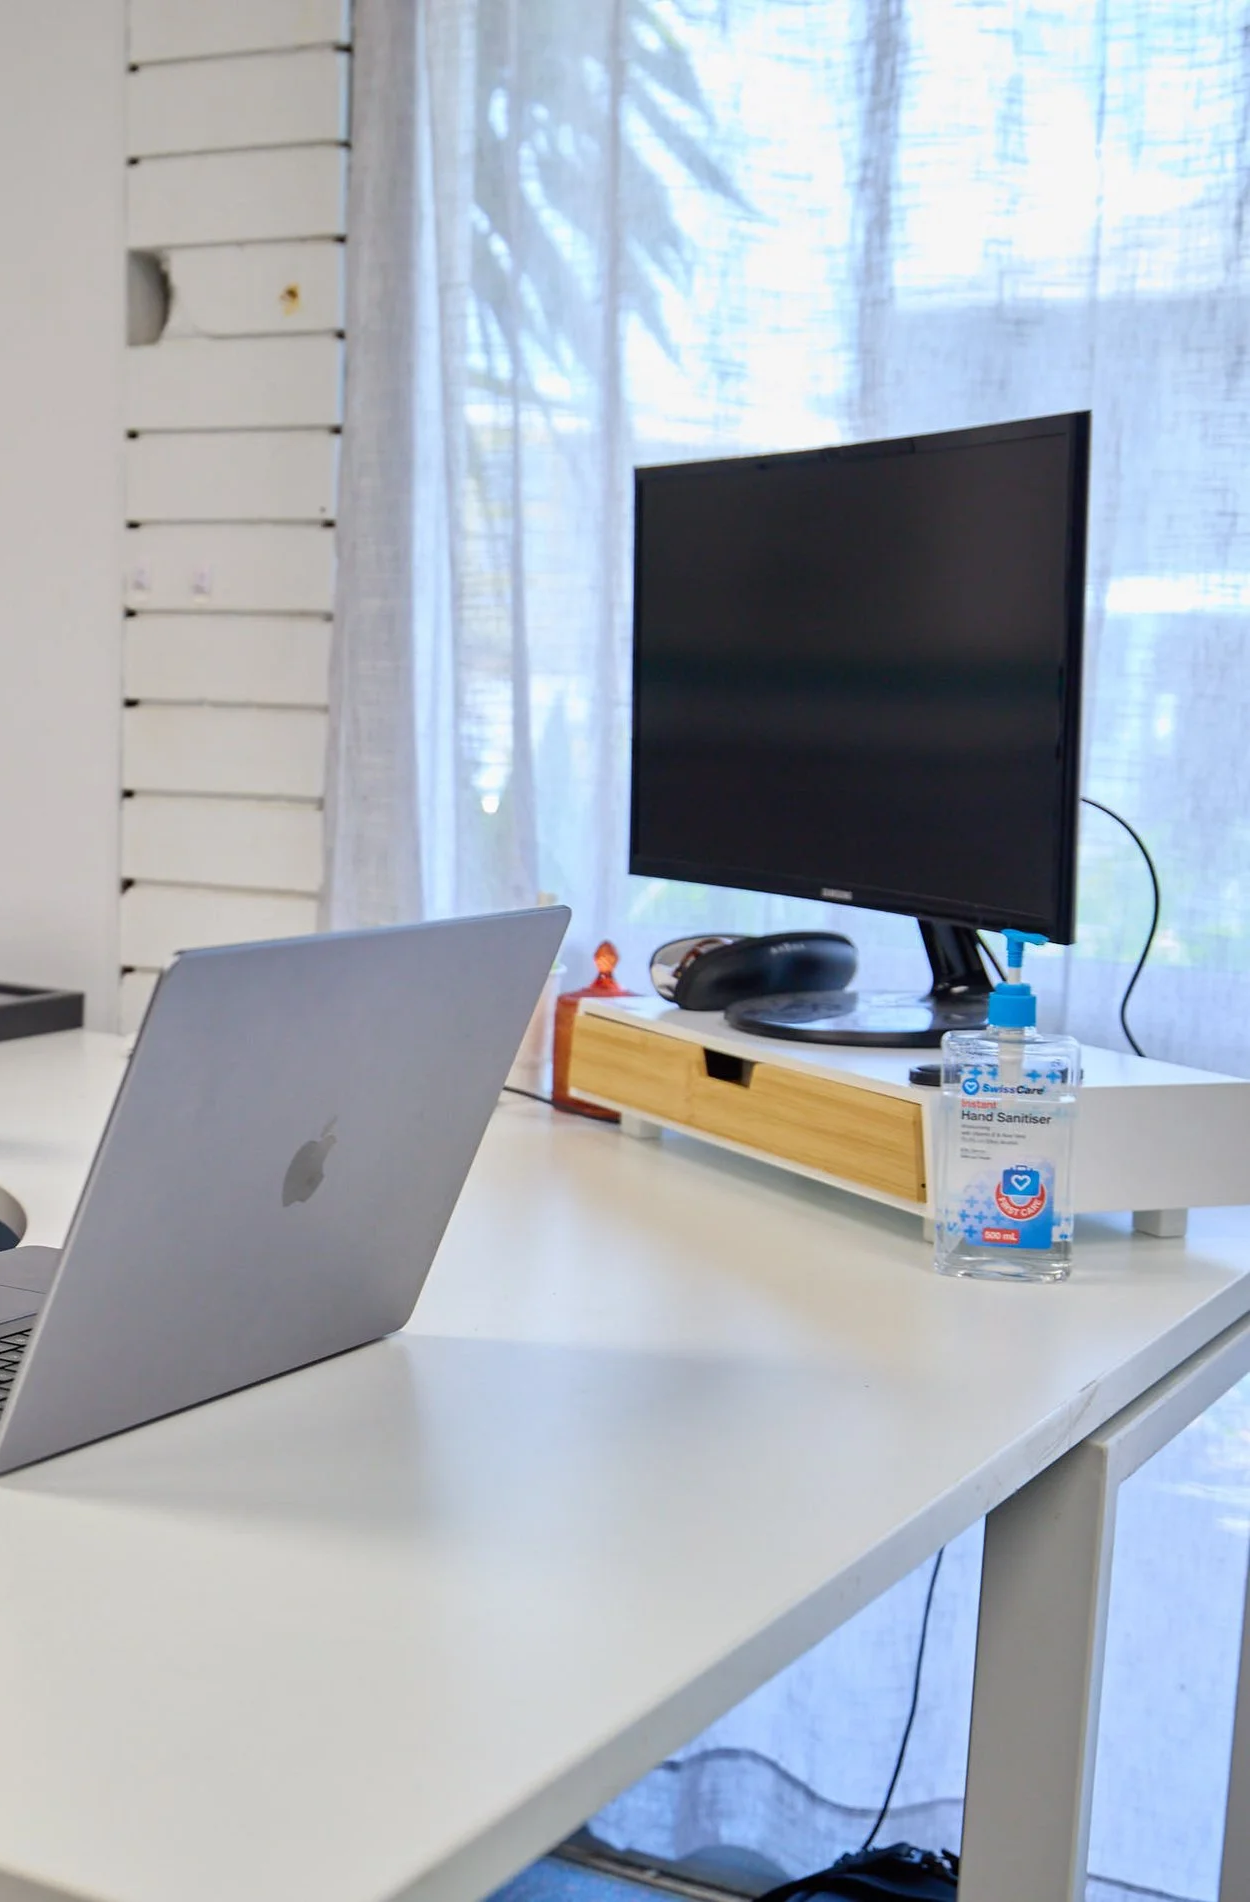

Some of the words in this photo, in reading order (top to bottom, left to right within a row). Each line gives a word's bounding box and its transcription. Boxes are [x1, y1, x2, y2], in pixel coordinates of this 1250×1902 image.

[961, 1099, 998, 1109] Instant
[961, 1110, 993, 1122] Hand
[997, 1112, 1052, 1125] Sanitiser
[984, 1230, 1001, 1240] 500
